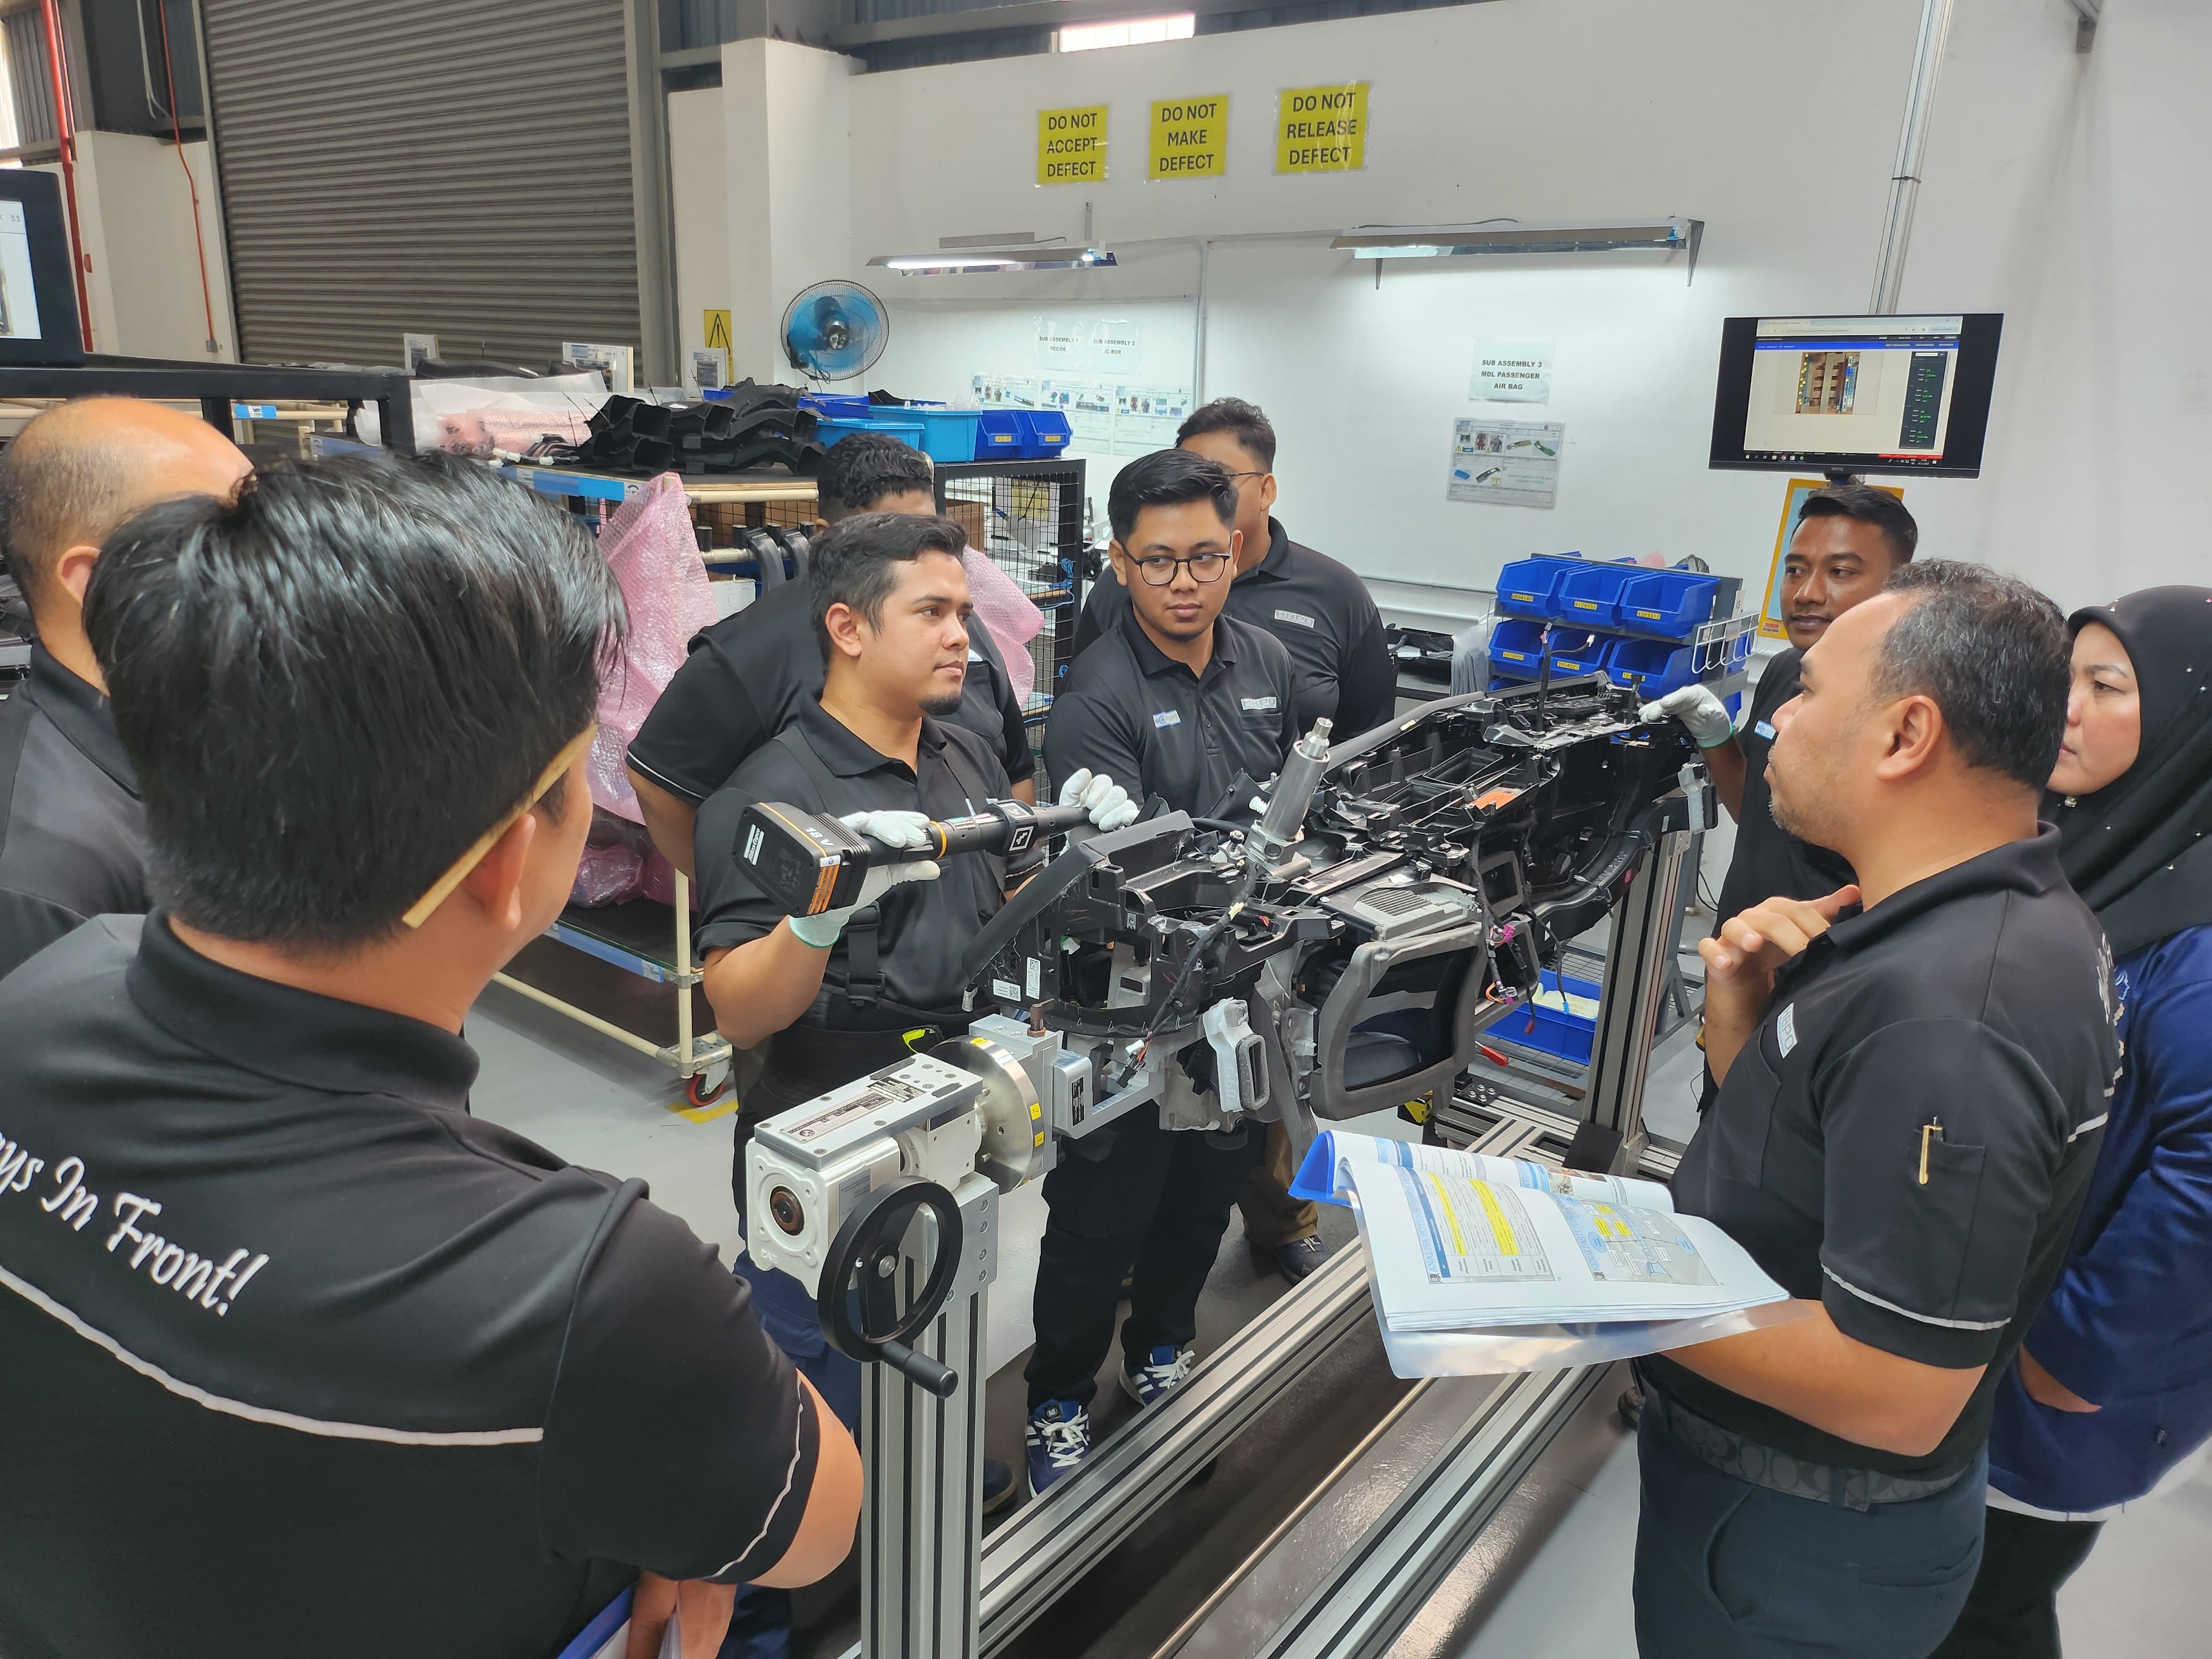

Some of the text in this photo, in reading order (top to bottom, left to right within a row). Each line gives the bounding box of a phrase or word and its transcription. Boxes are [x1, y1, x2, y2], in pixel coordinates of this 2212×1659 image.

[1292, 92, 1357, 112] DO NOT
[1048, 113, 1098, 131] DO NOT
[1162, 103, 1217, 123] DO NOT
[1287, 119, 1358, 139] RELEASE
[1046, 137, 1098, 154] ACCEPT
[1167, 130, 1207, 147] MAKE
[1159, 154, 1214, 172] DEFECT
[1288, 146, 1352, 165] DEFECT
[1047, 161, 1096, 177] DEFECT
[752, 828, 760, 846] Copco
[806, 827, 823, 839] 18
[41, 1156, 100, 1232] In
[107, 1192, 270, 1317] Front!
